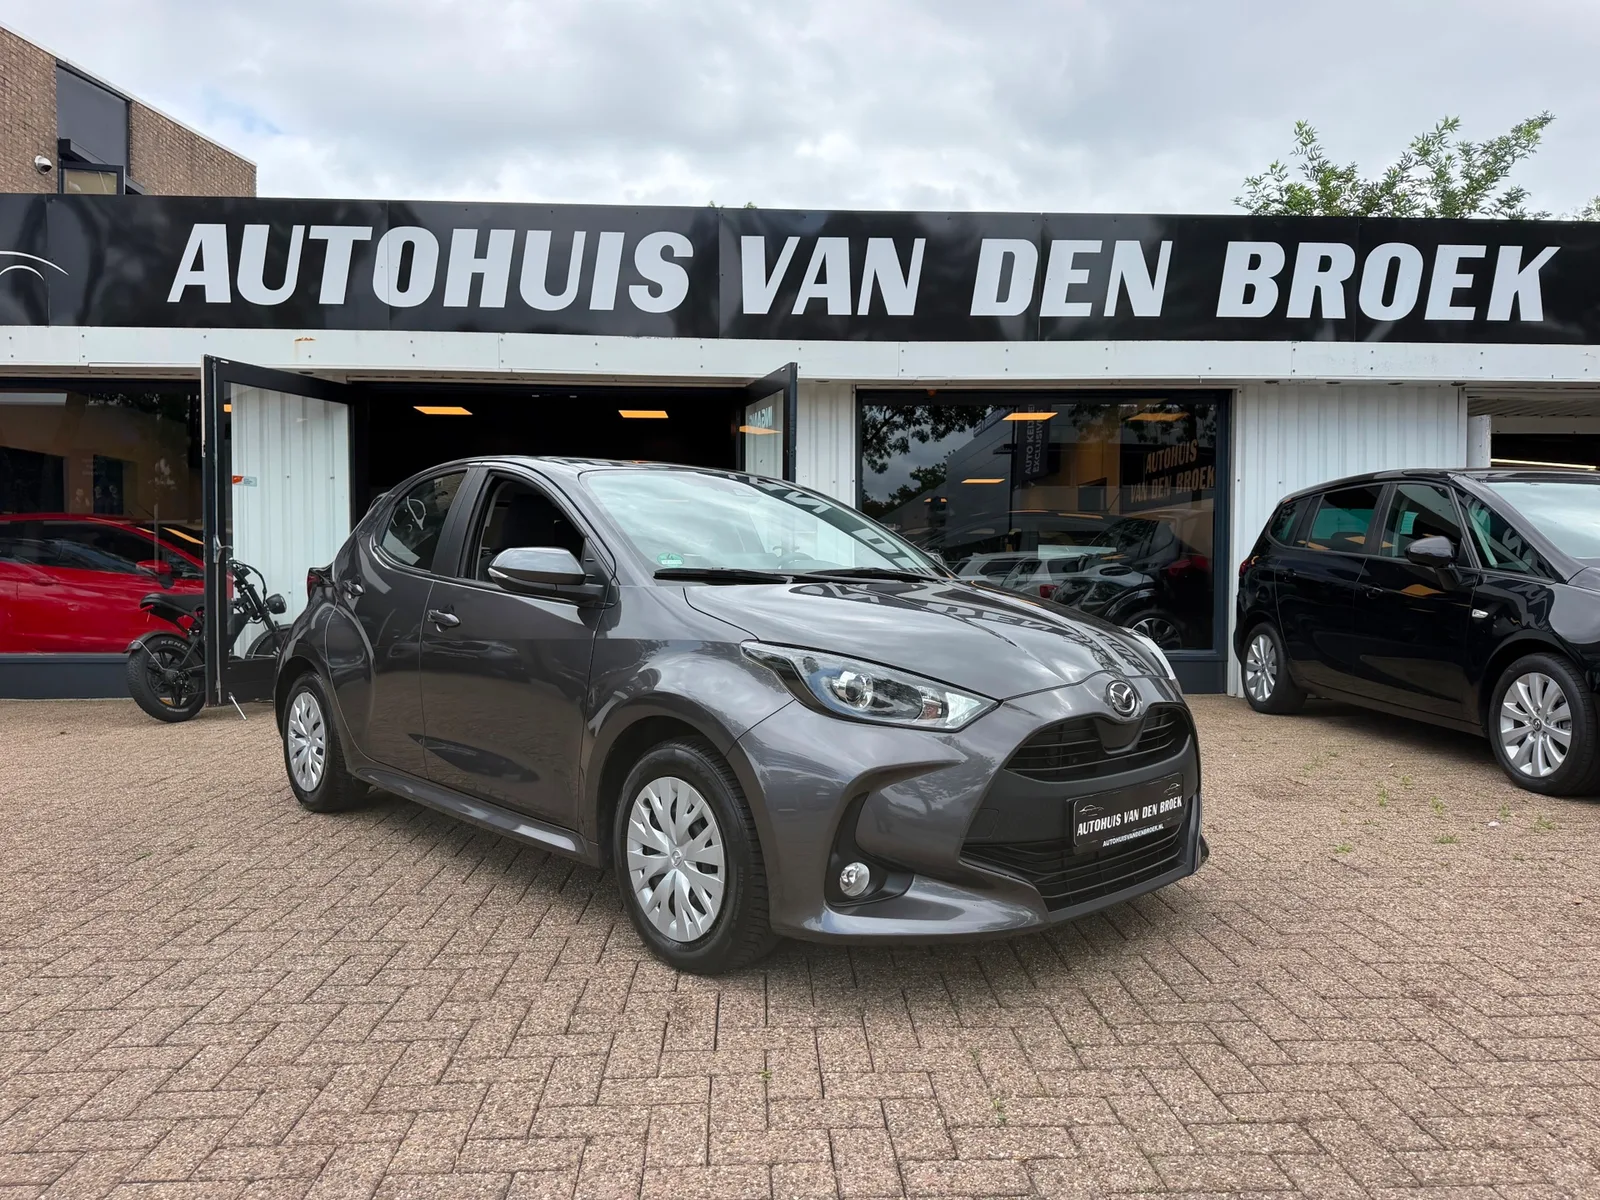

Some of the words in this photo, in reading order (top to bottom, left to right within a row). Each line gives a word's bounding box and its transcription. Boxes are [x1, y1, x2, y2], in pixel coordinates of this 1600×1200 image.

[167, 223, 694, 314] AUTOHUIS
[741, 235, 927, 317] VAN
[970, 238, 1173, 318] DEN
[1216, 241, 1561, 322] BROEK
[1026, 404, 1036, 443] KEIJE
[1032, 409, 1044, 473] EXCLUSIV
[1024, 445, 1035, 475] AUTO
[1145, 439, 1198, 474] AUTOHUIS
[1130, 481, 1148, 503] VAN
[1151, 475, 1172, 499] DEN
[1175, 465, 1215, 495] BROEK
[160, 640, 188, 650] KEND
[1076, 815, 1122, 837] AUTOHUIS
[1124, 808, 1139, 823] VAN
[1142, 804, 1158, 818] DEN
[1160, 796, 1182, 813] BROEK
[1103, 824, 1164, 847] AUTOHUISVANDENBROEK.NL
